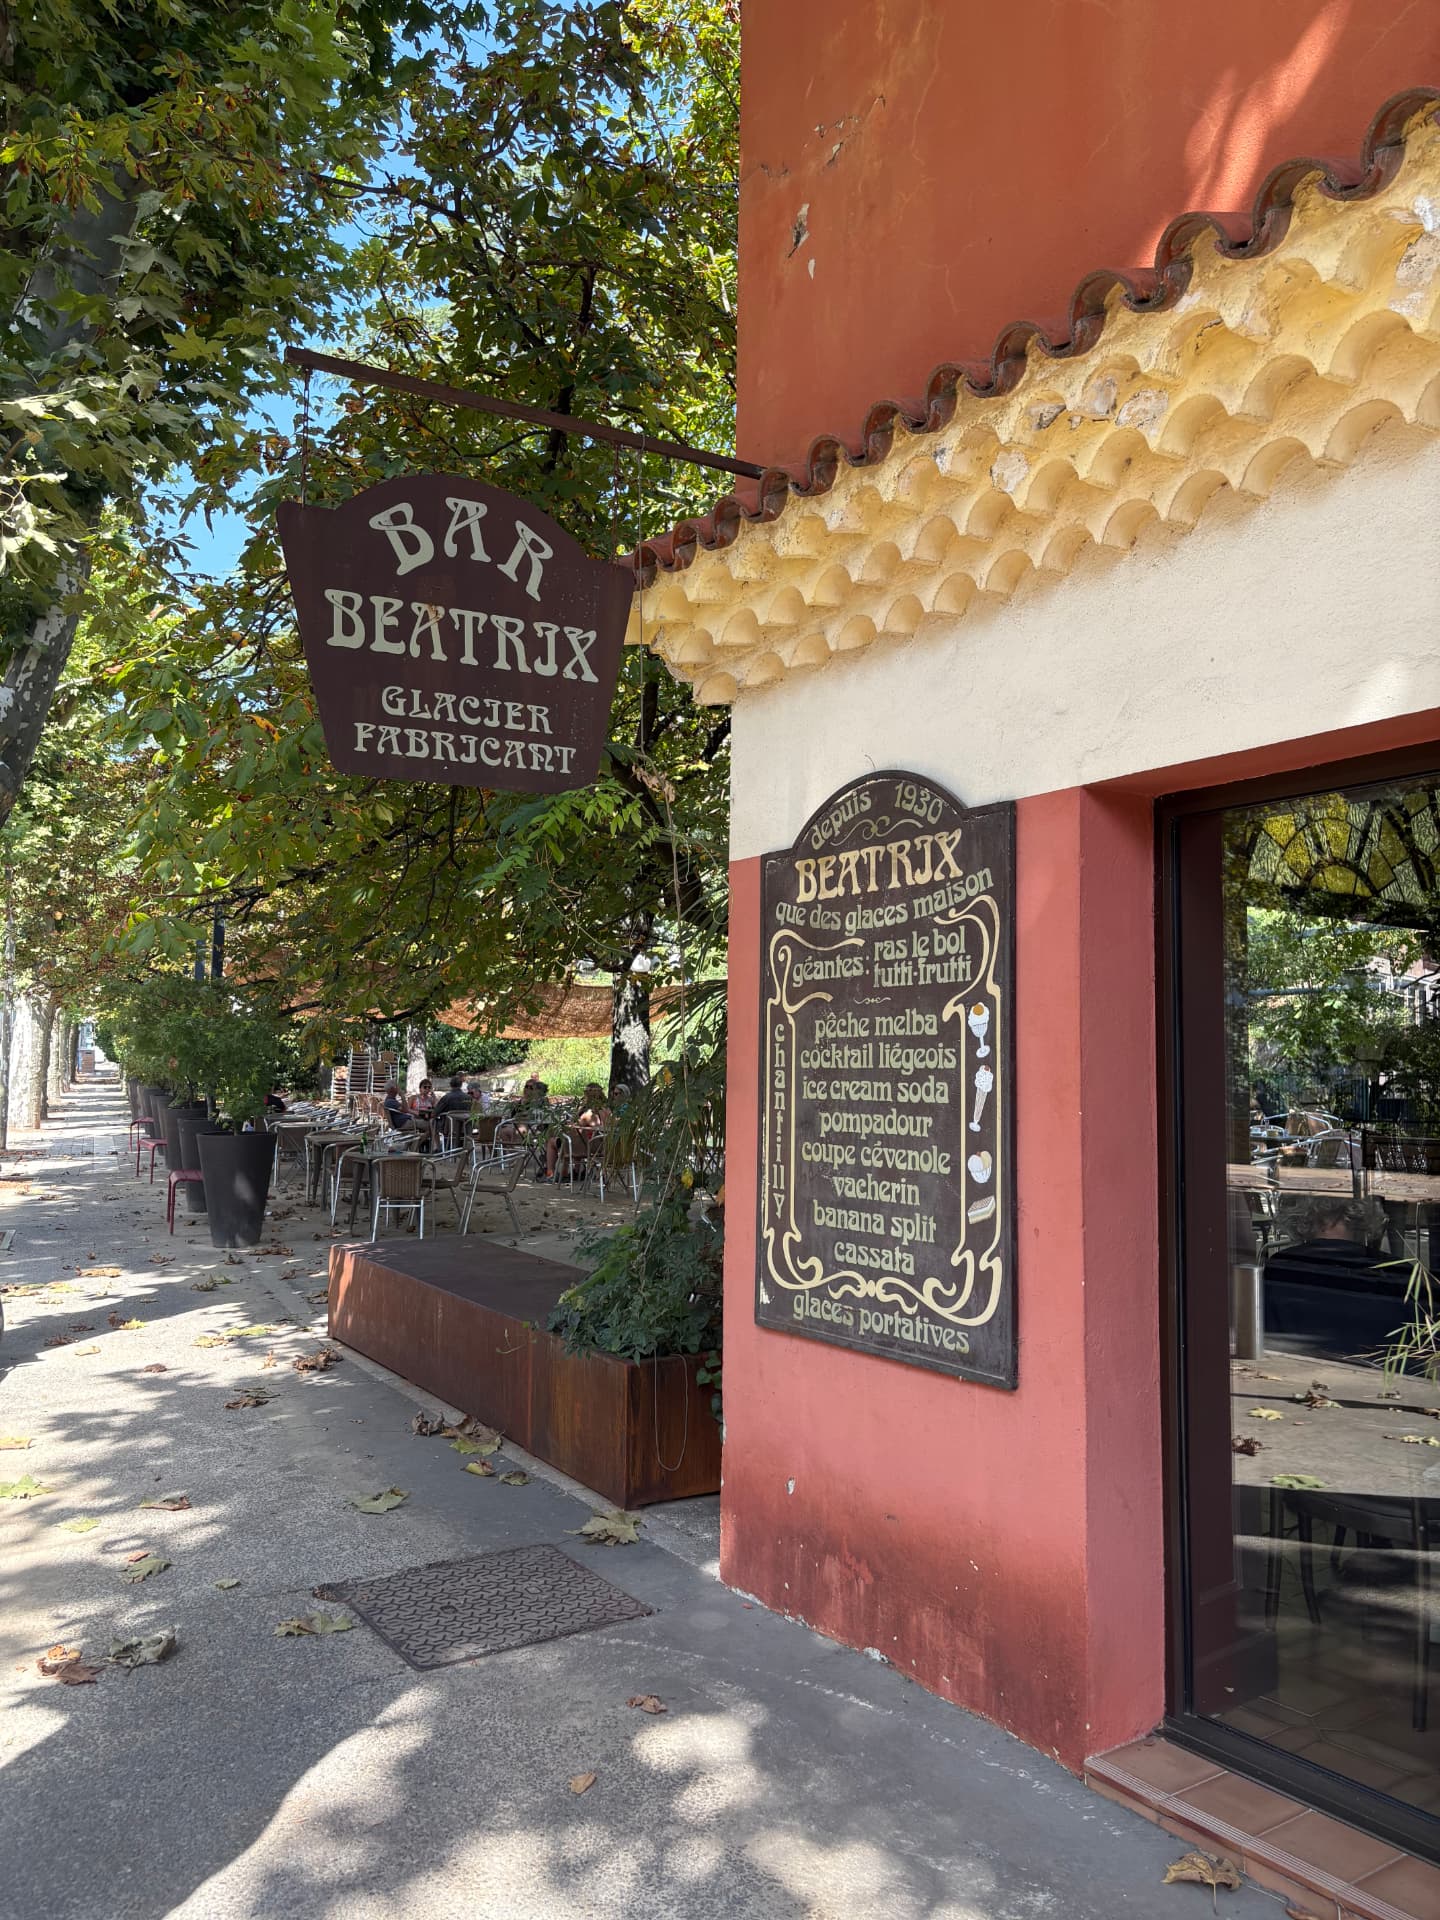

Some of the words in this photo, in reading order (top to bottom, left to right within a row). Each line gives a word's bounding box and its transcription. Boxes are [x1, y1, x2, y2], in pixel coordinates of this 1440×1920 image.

[369, 497, 553, 602] BAR
[324, 588, 599, 683] BEATRIX
[381, 686, 553, 734] GLACIER
[353, 722, 577, 774] FABRICANT
[811, 791, 872, 850] depuis
[895, 782, 943, 824] 1930
[795, 828, 963, 903] BEATRIX
[775, 901, 806, 926] que
[809, 904, 841, 929] des
[845, 902, 908, 936] glaces
[913, 867, 994, 919] maison
[874, 938, 907, 961] ras
[912, 931, 930, 957] le
[933, 925, 966, 956] bol
[814, 1013, 870, 1043] pêche
[874, 1008, 938, 1037] melba
[800, 1043, 873, 1070] cocktail
[878, 1043, 957, 1075] liégeois
[802, 1076, 828, 1099] ice
[830, 1081, 892, 1102] cream
[897, 1075, 949, 1104] soda
[773, 1023, 786, 1219] chantilly
[818, 1108, 933, 1140] pompadour
[801, 1141, 856, 1171] coupe
[860, 1140, 951, 1175] cévenole
[832, 1173, 921, 1206] vacherin
[813, 1199, 885, 1236] banana
[890, 1214, 937, 1246] split
[834, 1240, 916, 1276] cassata
[793, 1290, 855, 1327] glaces
[858, 1309, 970, 1354] portatives
